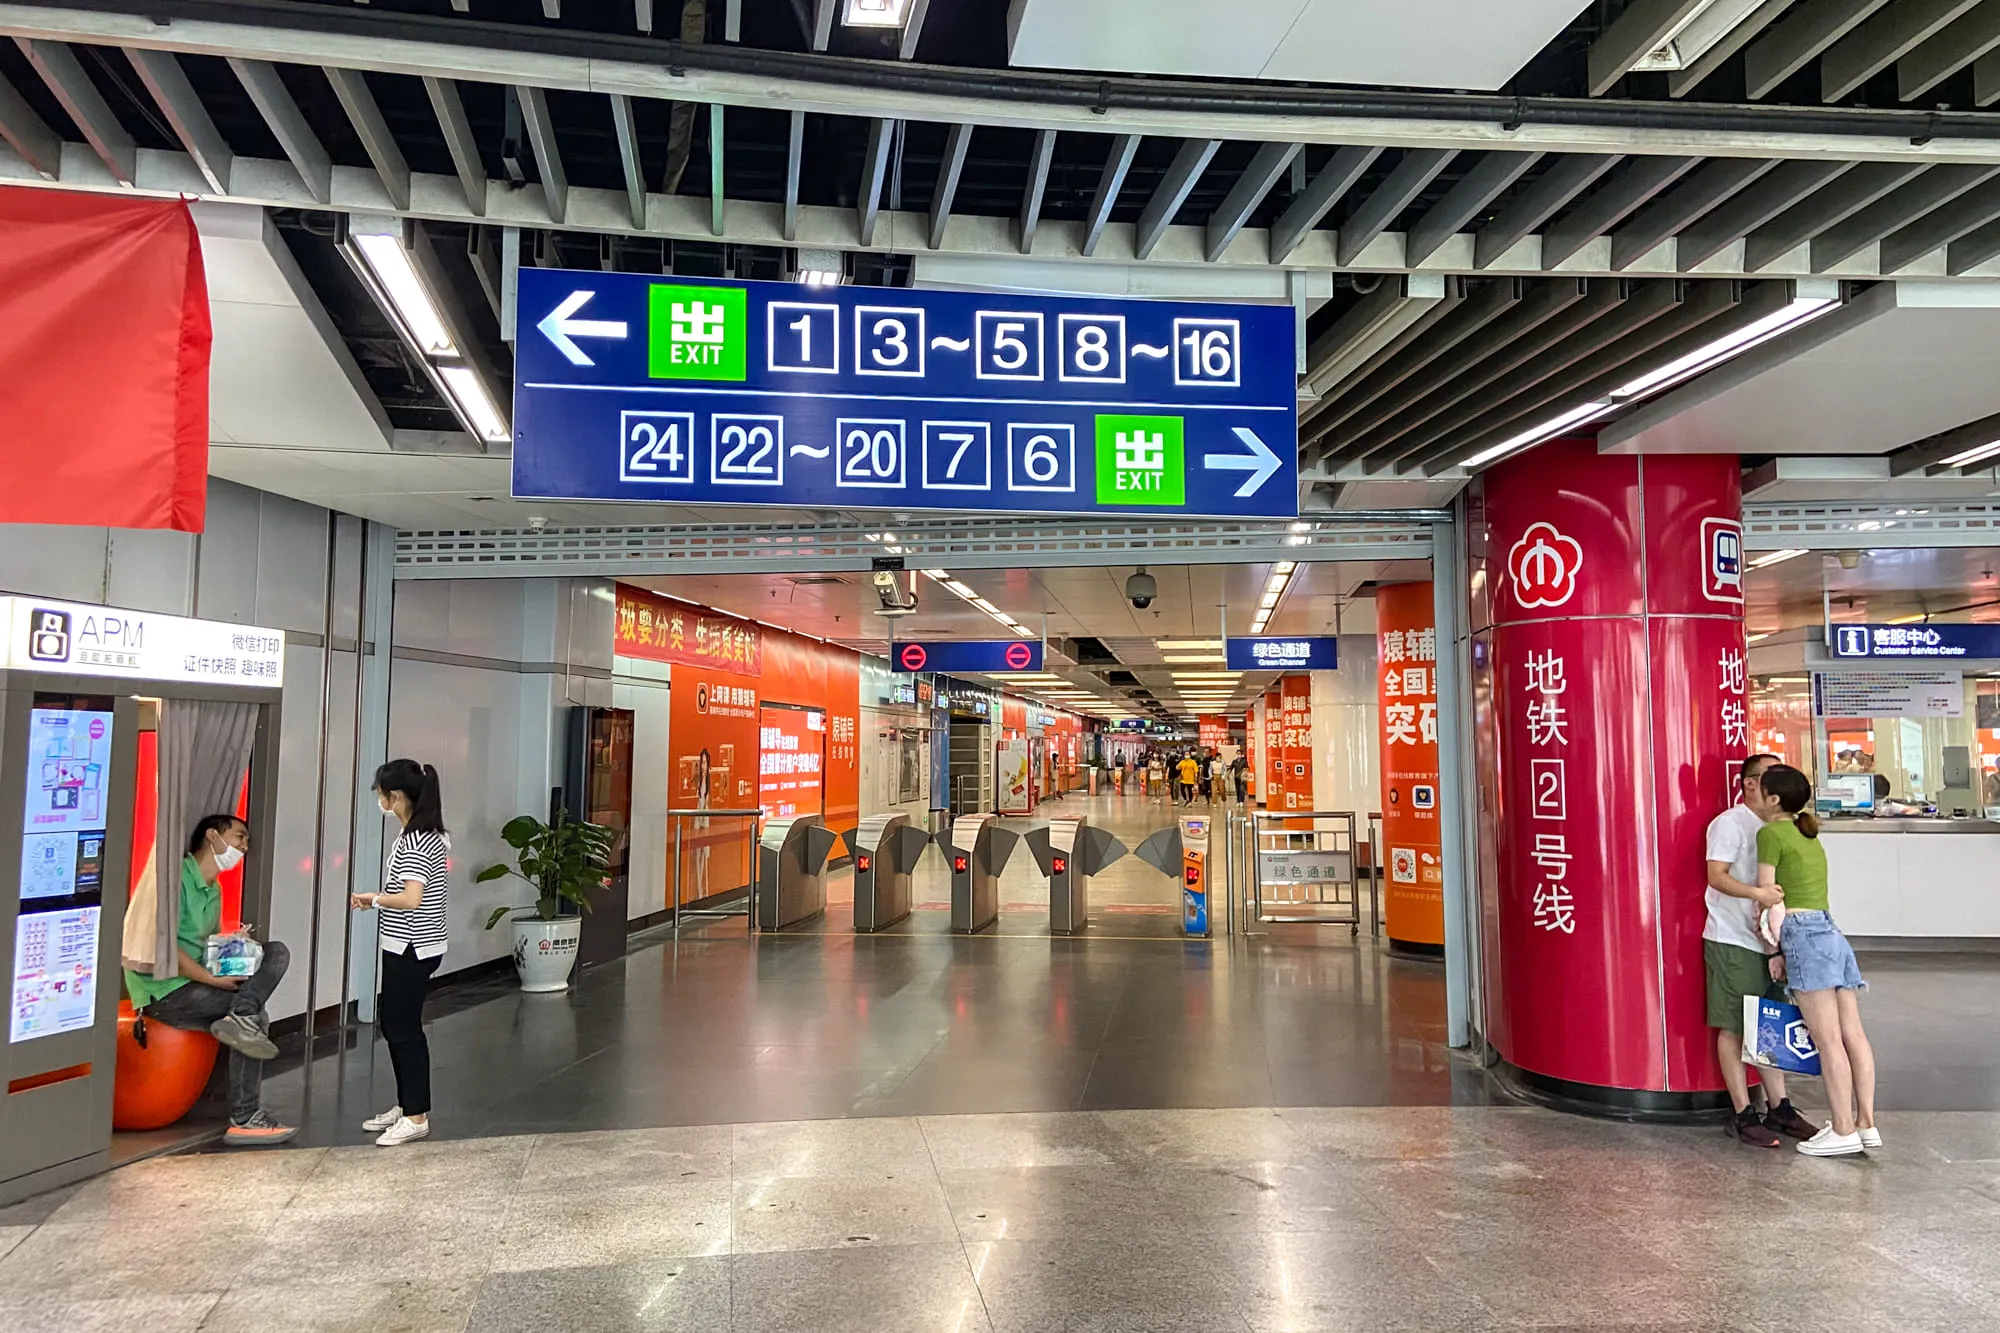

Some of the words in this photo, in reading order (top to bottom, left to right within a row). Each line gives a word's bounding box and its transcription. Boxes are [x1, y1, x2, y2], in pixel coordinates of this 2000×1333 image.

[789, 314, 811, 362] 1
[670, 343, 724, 365] EXIT
[628, 422, 684, 472] 24
[938, 433, 975, 479] 7
[1023, 434, 1060, 482] 6
[1115, 471, 1164, 491] EXIT
[79, 615, 144, 649] APM
[615, 597, 684, 652] 圾要分类
[232, 634, 280, 655] 微信打印
[1873, 628, 1941, 646] 客服中心
[1253, 642, 1311, 658] 绿色通道
[1873, 647, 1910, 656] Customer
[1911, 647, 1938, 656] Service
[1939, 647, 1966, 656] Center
[184, 655, 237, 676] 证件快照
[240, 659, 278, 678] 趣味照
[1258, 658, 1279, 666] Green
[1279, 658, 1306, 666] Channel
[1384, 667, 1437, 697] 全国
[1273, 865, 1337, 879] 绿色通道
